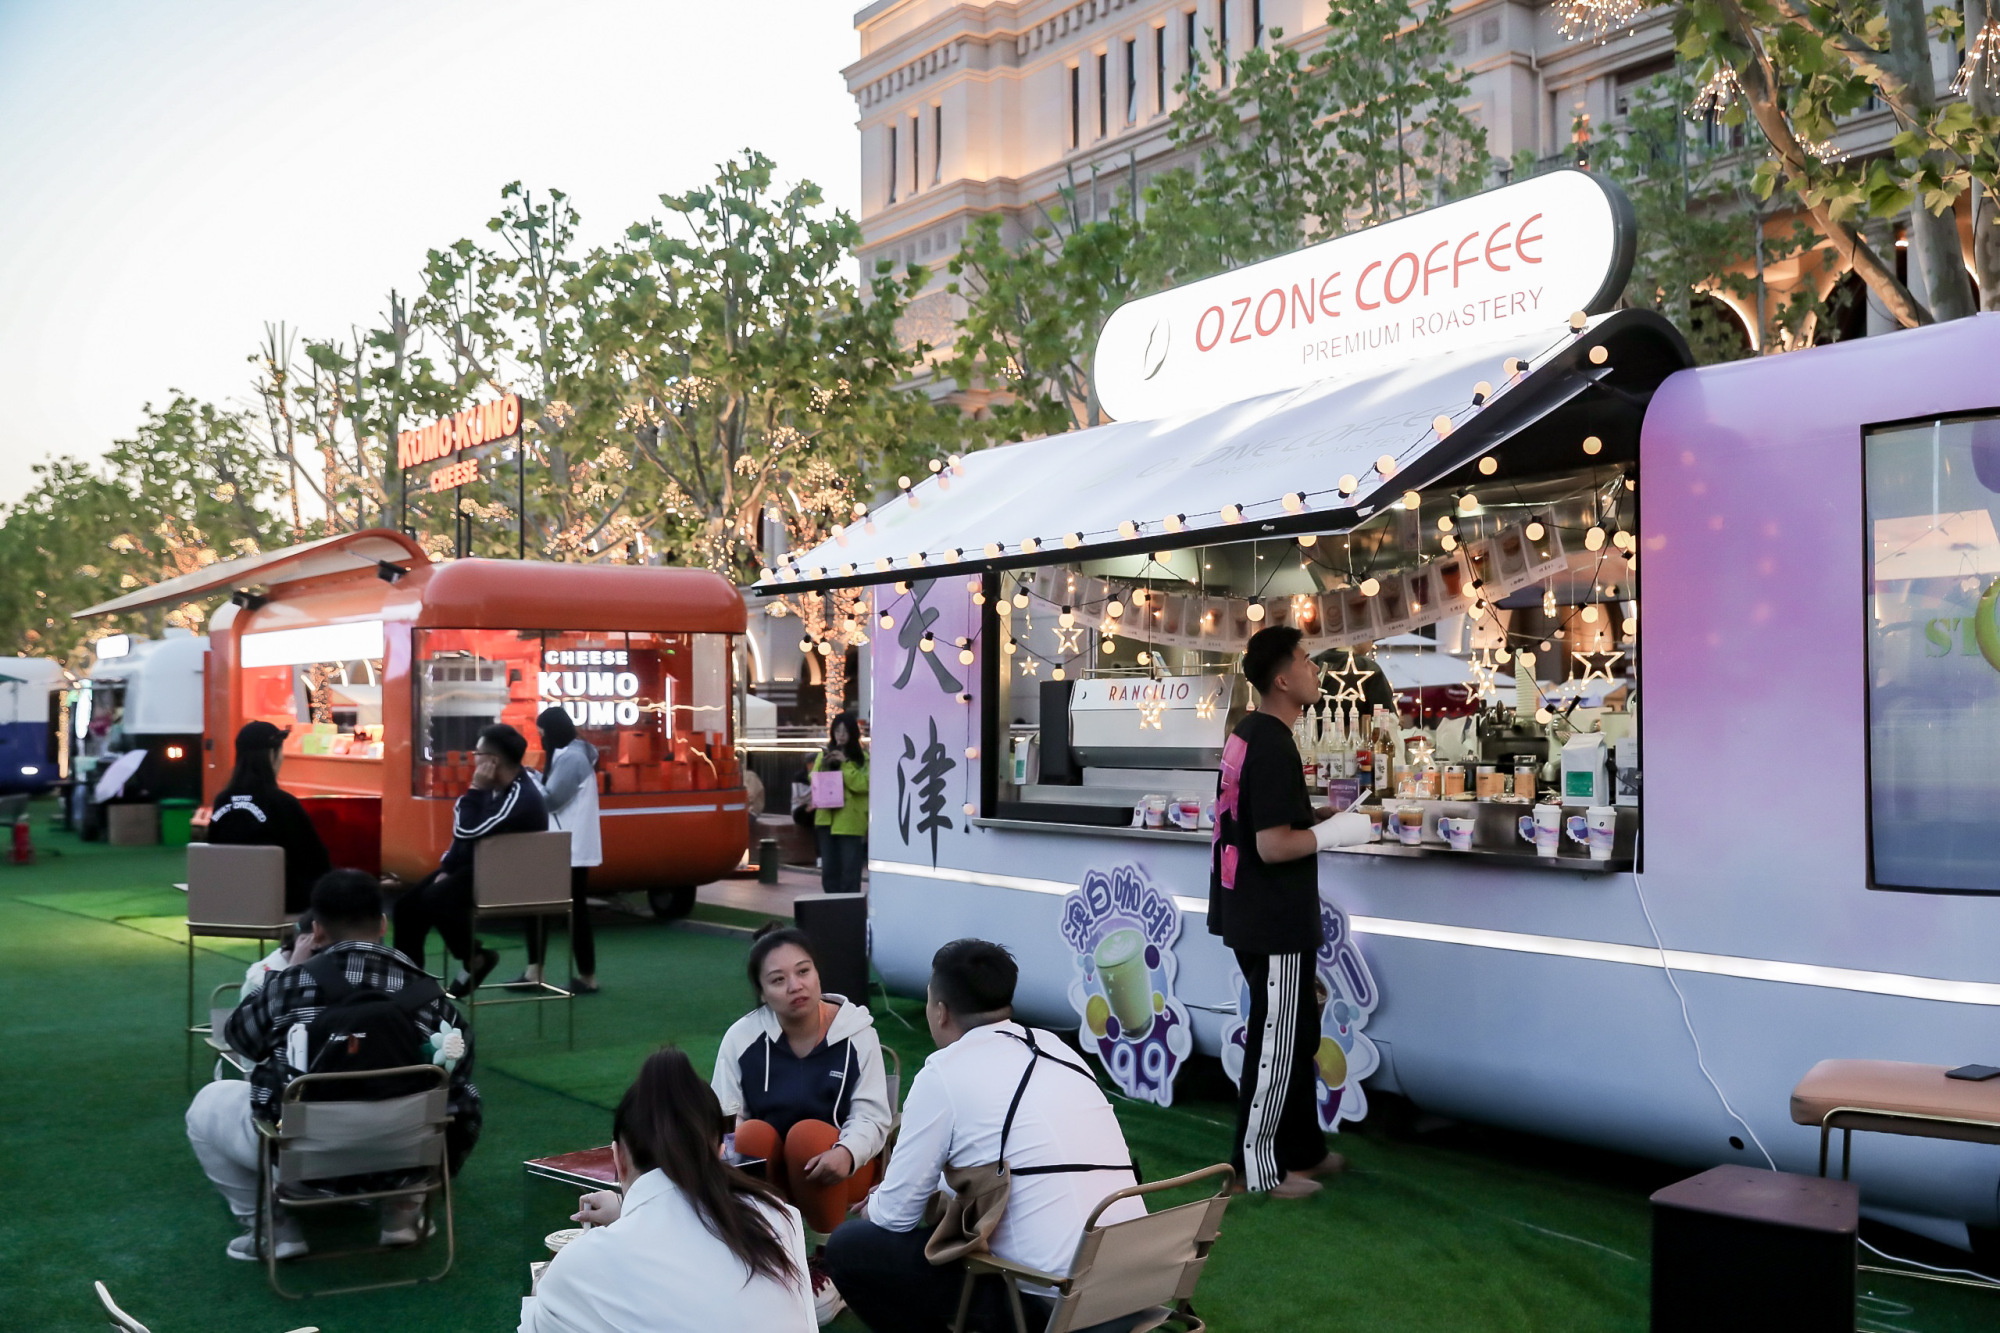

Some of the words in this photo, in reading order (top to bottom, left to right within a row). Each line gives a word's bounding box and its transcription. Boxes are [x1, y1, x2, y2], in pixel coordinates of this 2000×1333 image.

[1195, 271, 1341, 353] OZONE
[1355, 212, 1543, 311] COFFEE
[1303, 322, 1400, 365] PREMIUM
[1412, 286, 1544, 339] ROASTERY
[430, 458, 478, 494] CHEESE
[544, 650, 628, 666] CHEESE
[538, 671, 639, 697] KUMO
[1108, 682, 1190, 701] RANCILIO
[1062, 869, 1174, 952] 澳白咖啡
